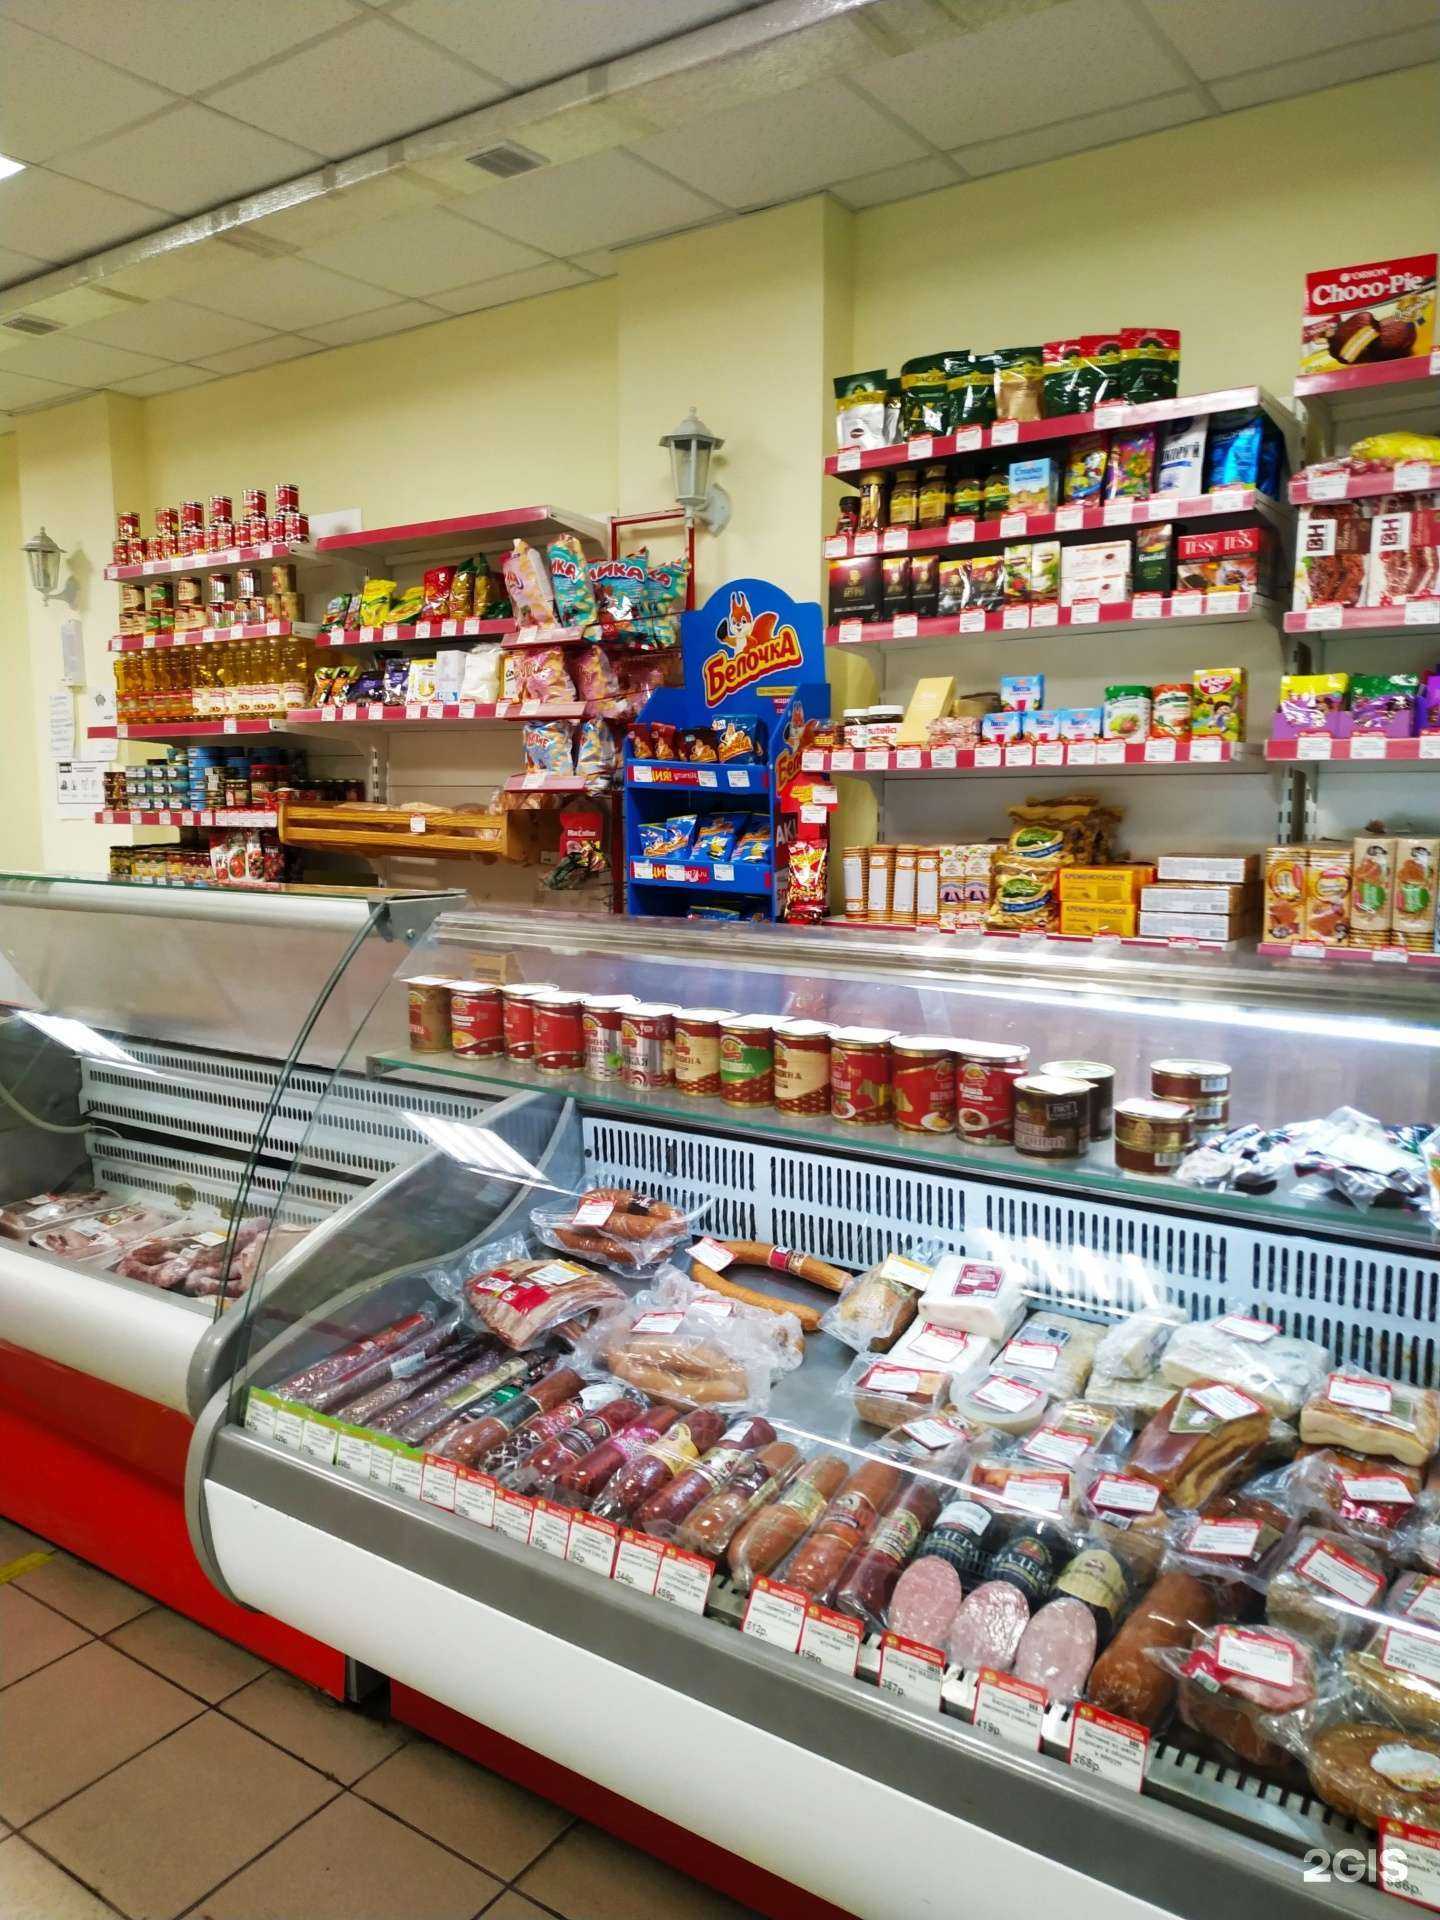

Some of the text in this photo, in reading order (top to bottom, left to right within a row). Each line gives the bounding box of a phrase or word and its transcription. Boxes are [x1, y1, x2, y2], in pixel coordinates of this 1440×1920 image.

[1351, 267, 1390, 280] ORION
[1312, 271, 1424, 306] Choco-Pie
[1185, 538, 1218, 555] TESS
[1224, 531, 1253, 550] TESS
